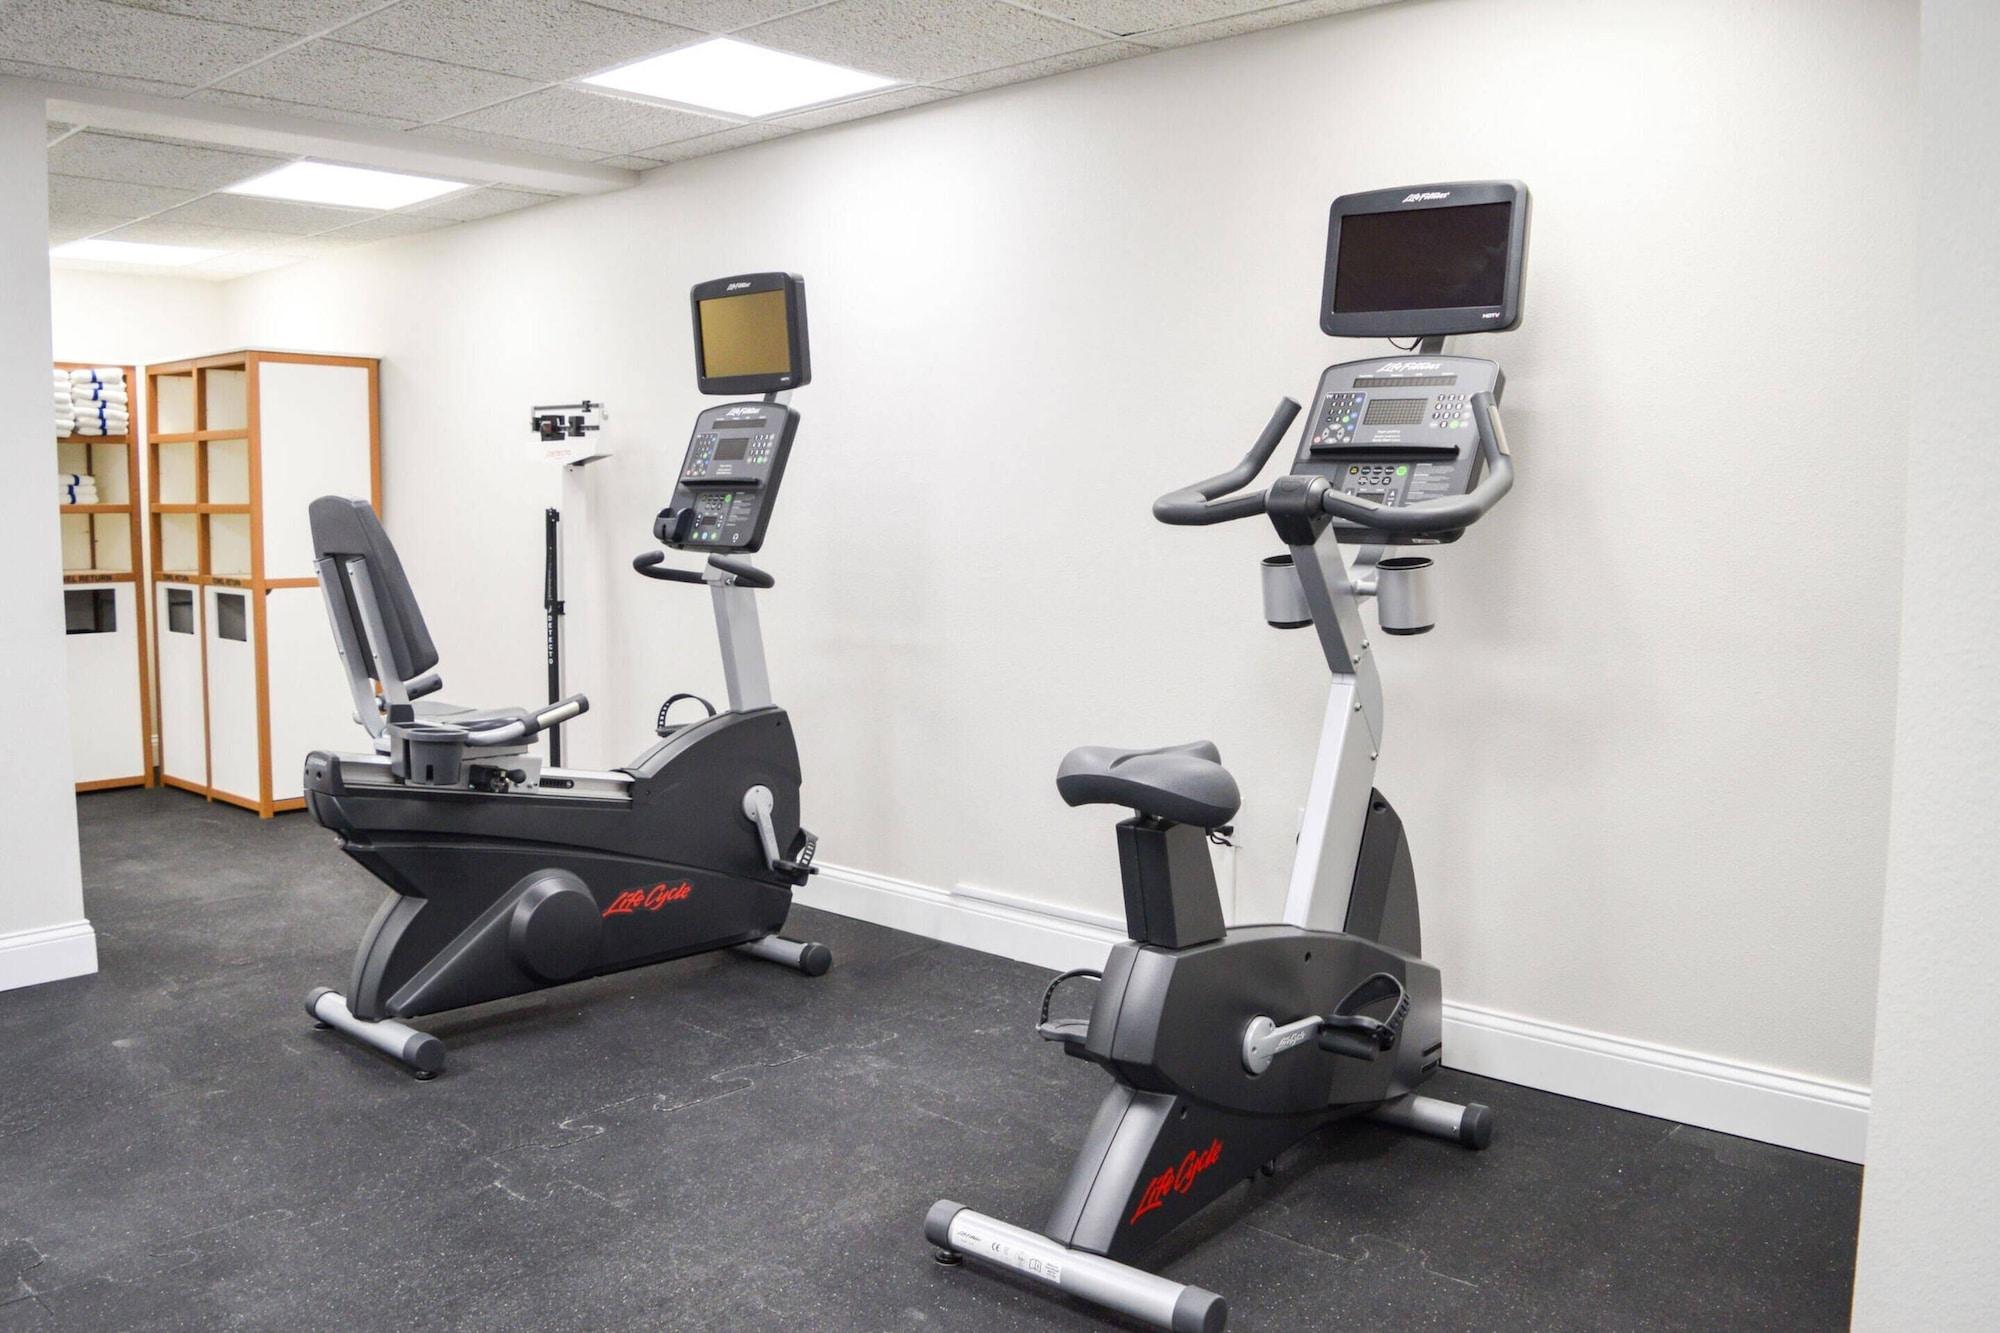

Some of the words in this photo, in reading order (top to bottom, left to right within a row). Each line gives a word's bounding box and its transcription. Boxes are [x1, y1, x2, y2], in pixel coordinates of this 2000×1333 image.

[1482, 311, 1501, 319] HDTV
[602, 888, 646, 918] Life
[644, 881, 692, 912] Cycle
[1129, 1167, 1176, 1226] Life
[1173, 1138, 1224, 1195] Cycle
